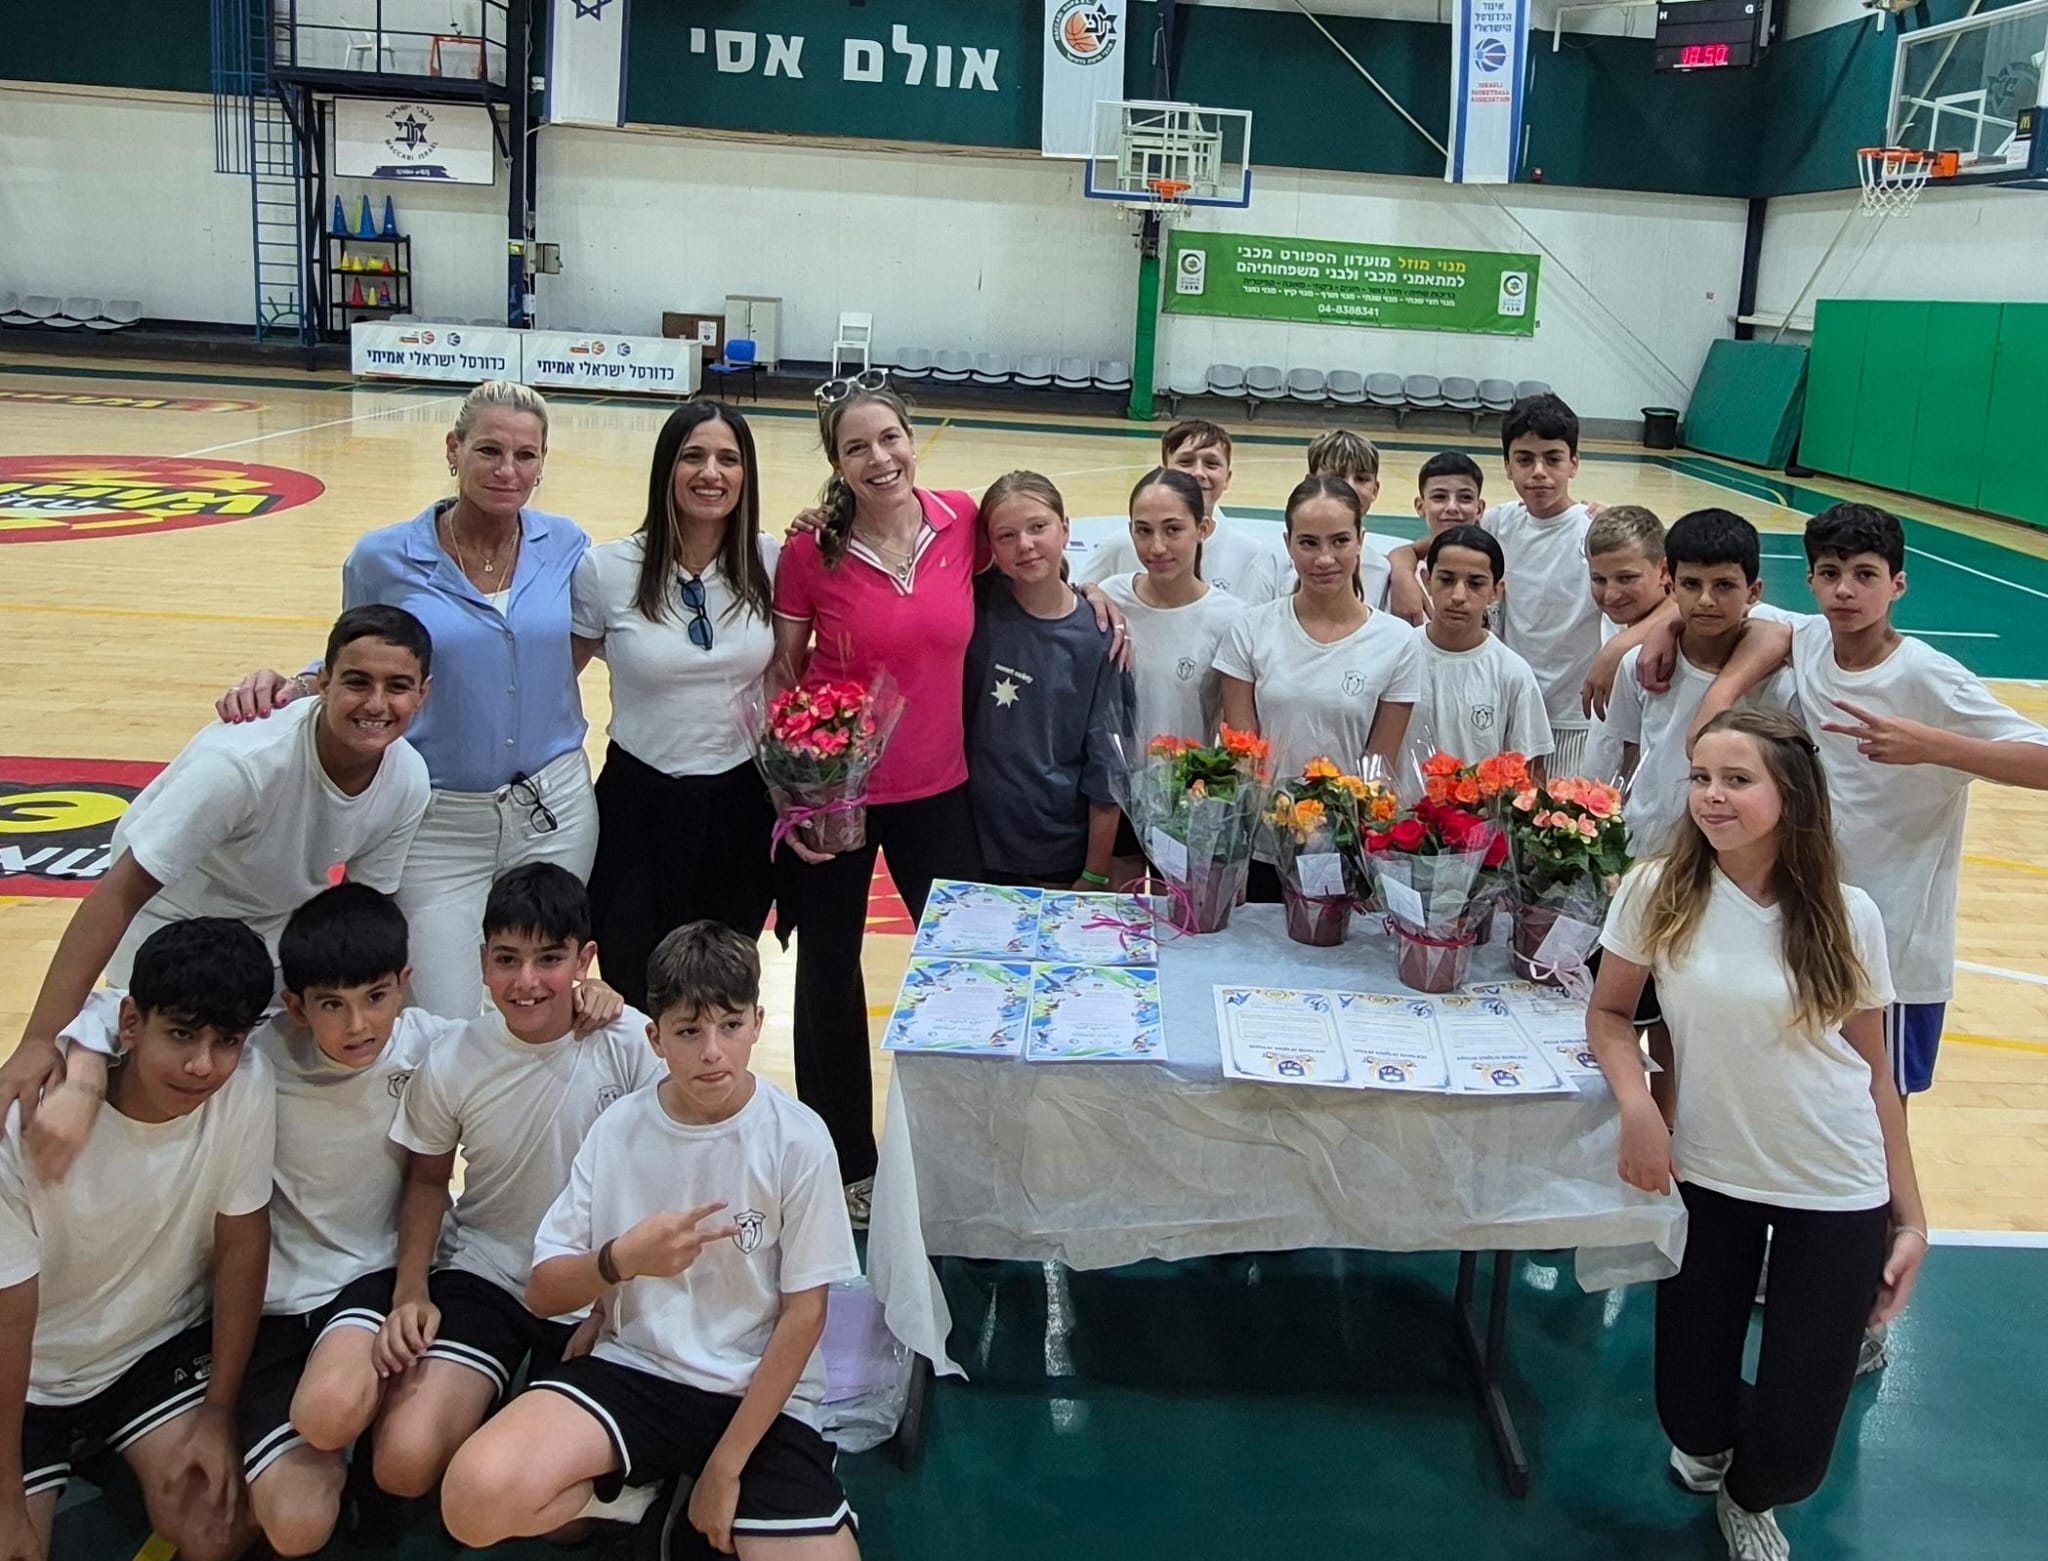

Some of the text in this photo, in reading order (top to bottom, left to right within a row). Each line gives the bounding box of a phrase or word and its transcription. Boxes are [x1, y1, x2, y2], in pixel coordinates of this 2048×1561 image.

[1474, 13, 1512, 21] הכדורסל
[1659, 11, 1668, 20] H
[1474, 24, 1512, 32] הישראלי
[690, 24, 999, 91] אולם אסי
[385, 139, 438, 160] MACCABI ISRAEL
[1237, 246, 1467, 273] מנוי מוזל מועדון הספורט מכבי
[1236, 261, 1466, 288] למתאמני מכבי ולבני משפחותיהם
[1317, 303, 1379, 316] 04-8388341
[367, 349, 505, 370] כדורסל ישראלי אמיתי
[537, 360, 674, 380] כדורסל ישראלי אמיתי
